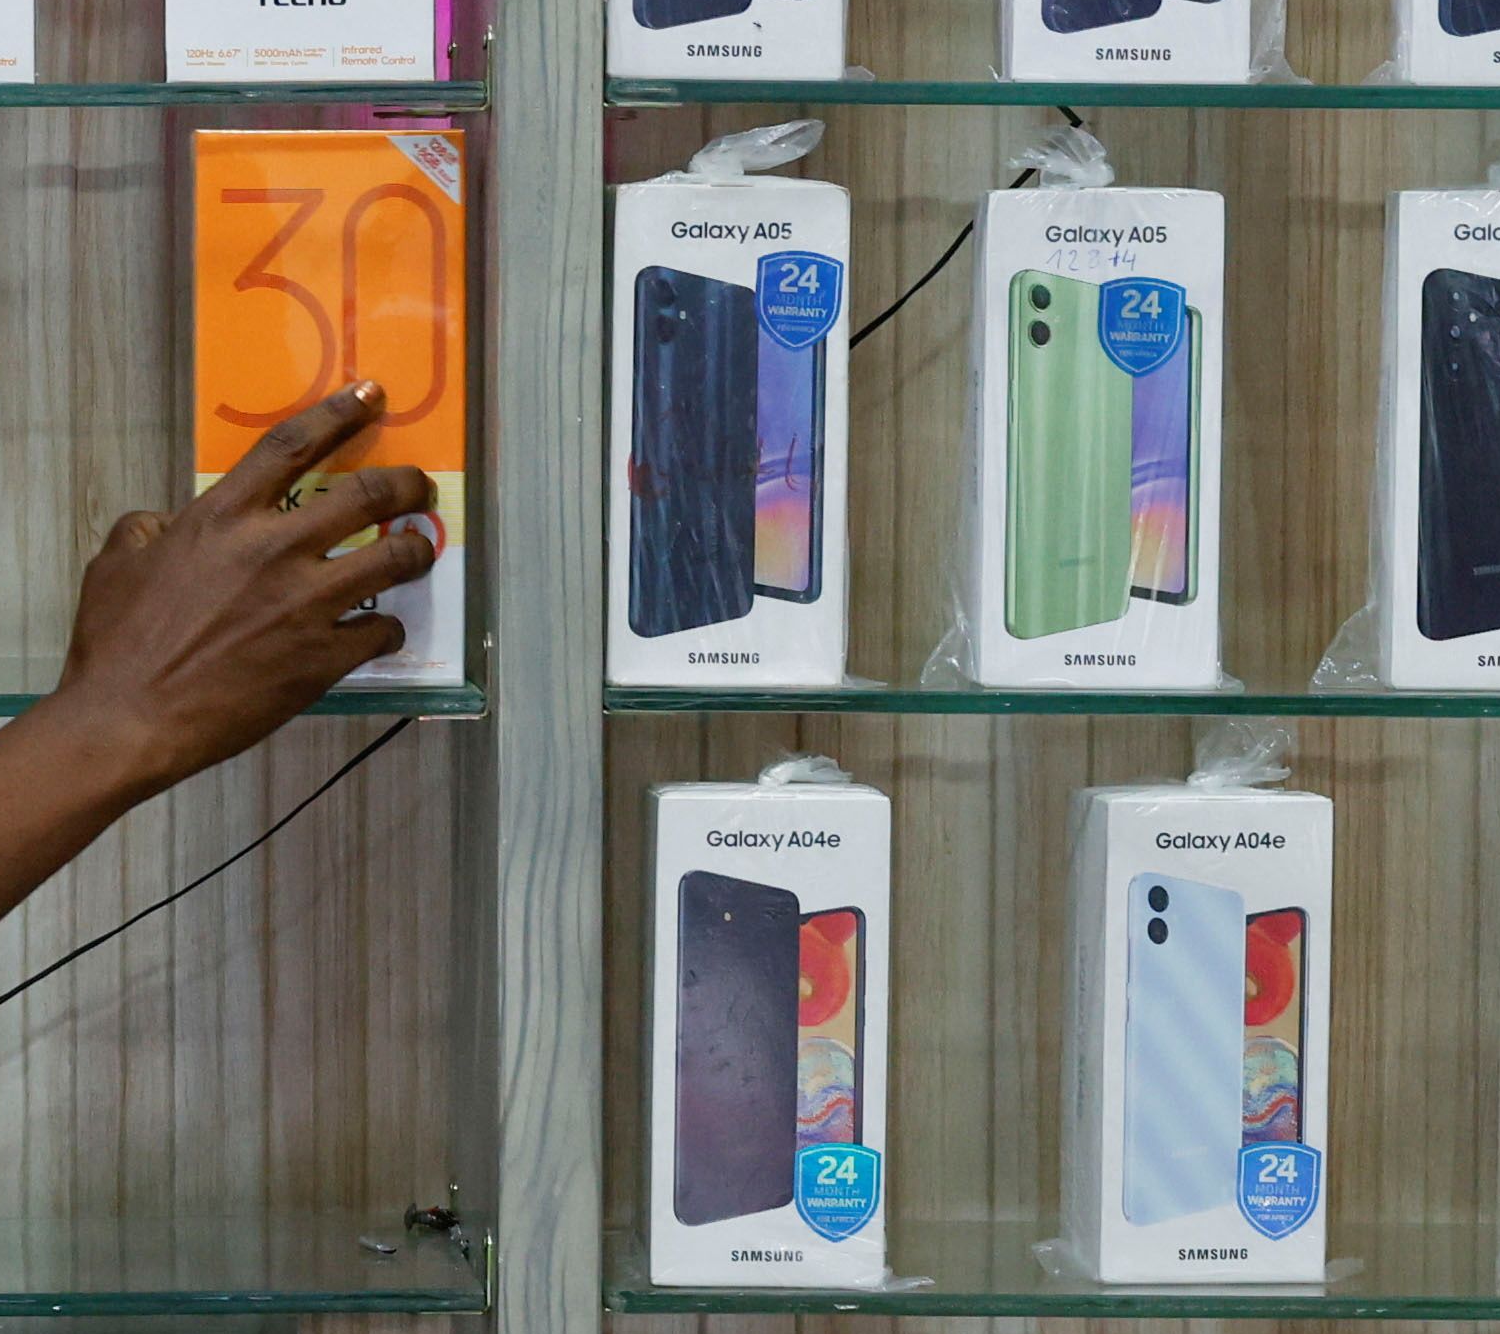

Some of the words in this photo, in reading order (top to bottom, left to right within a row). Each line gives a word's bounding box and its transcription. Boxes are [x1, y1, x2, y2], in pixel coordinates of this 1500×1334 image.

[1046, 225, 1124, 247] Galaxy
[1128, 226, 1168, 243] A05
[706, 829, 782, 852] Galaxy
[786, 831, 841, 849] A04e
